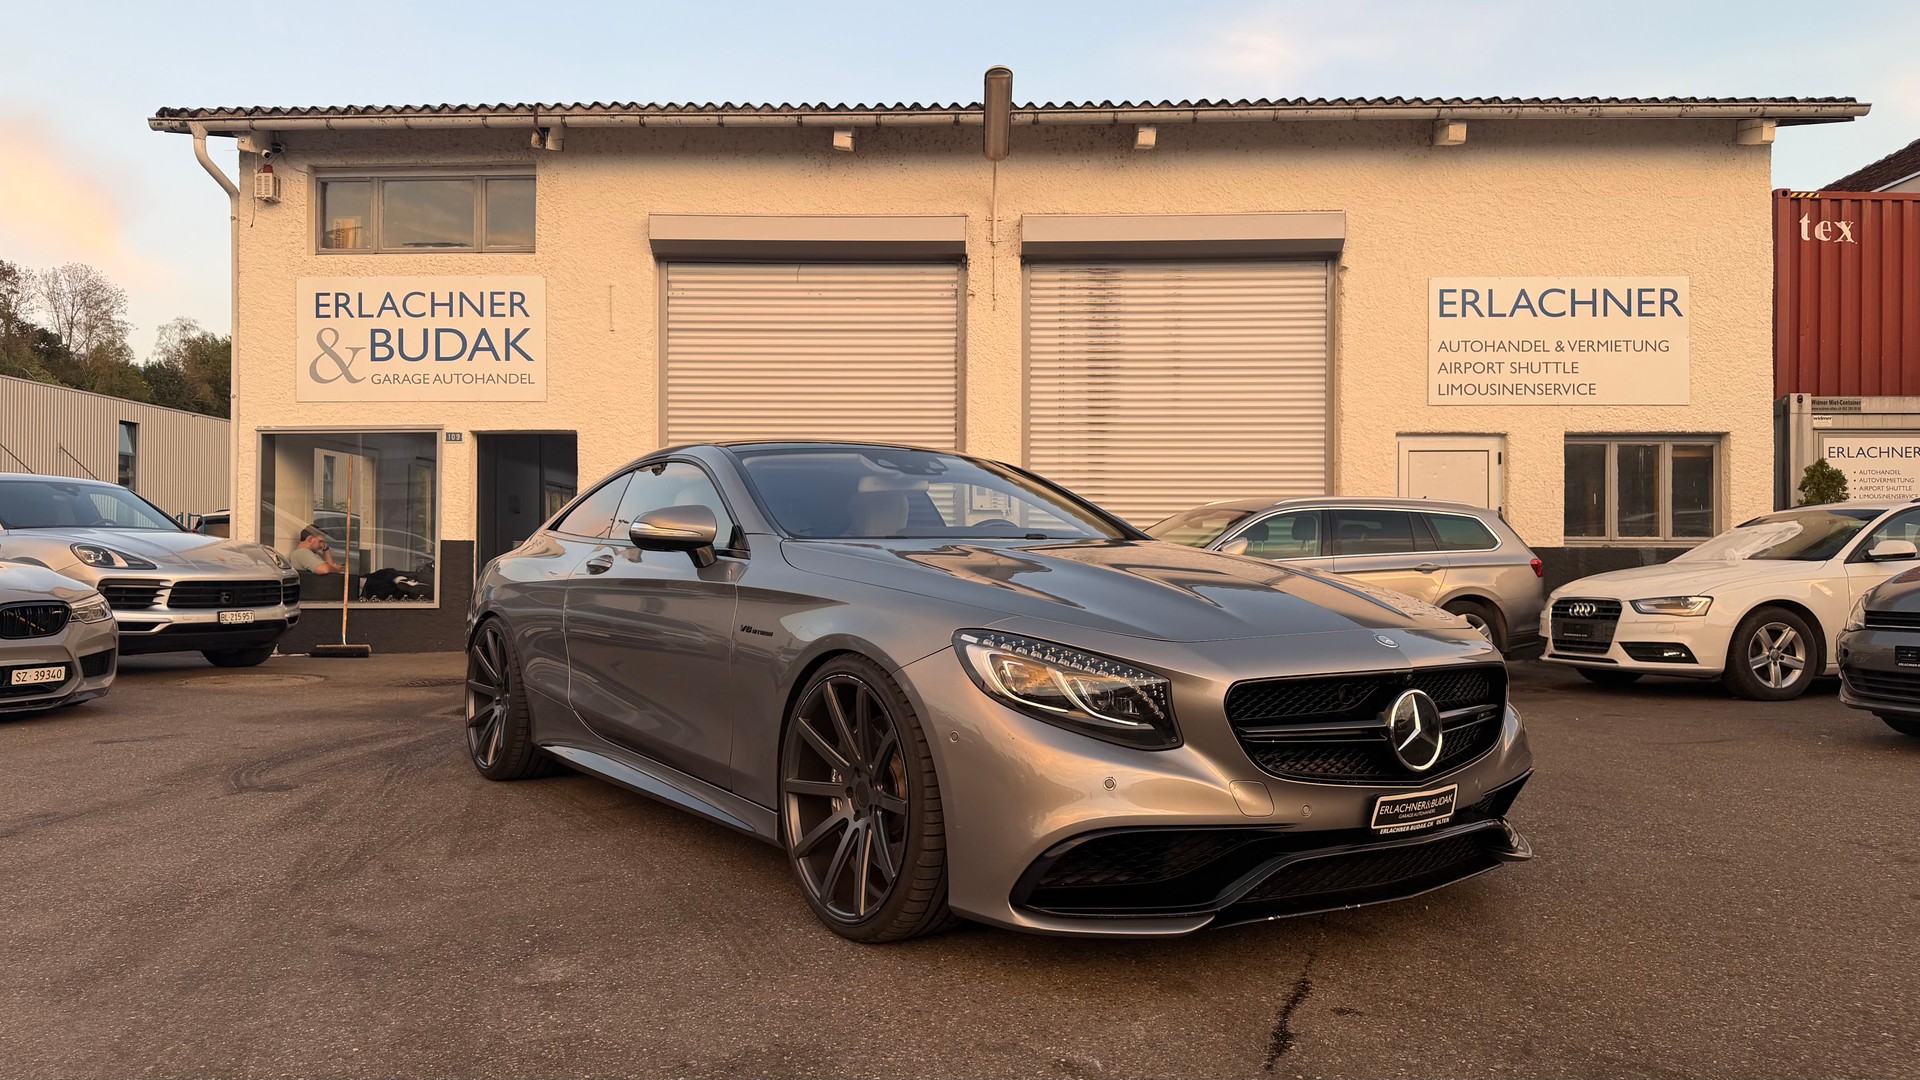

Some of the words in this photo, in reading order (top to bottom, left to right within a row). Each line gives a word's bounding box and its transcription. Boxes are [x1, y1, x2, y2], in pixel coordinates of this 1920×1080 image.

[315, 291, 530, 319] ERLACHNER
[1438, 288, 1683, 318] ERLACHNER
[1437, 340, 1550, 353] AUTOHANDEL
[1555, 341, 1565, 353] &
[1567, 339, 1670, 353] VERMIETUNG
[309, 327, 366, 384] &
[370, 328, 535, 362] BUDAK
[1437, 362, 1505, 374] AIRPORT
[1510, 361, 1579, 374] SHUTTLE
[371, 373, 430, 385] GARAGE
[432, 373, 535, 385] AUTOHANDEL
[1438, 383, 1597, 396] LIMOUSINENSERVICE
[447, 433, 461, 441] 109
[1828, 446, 1920, 459] ERLACHNER
